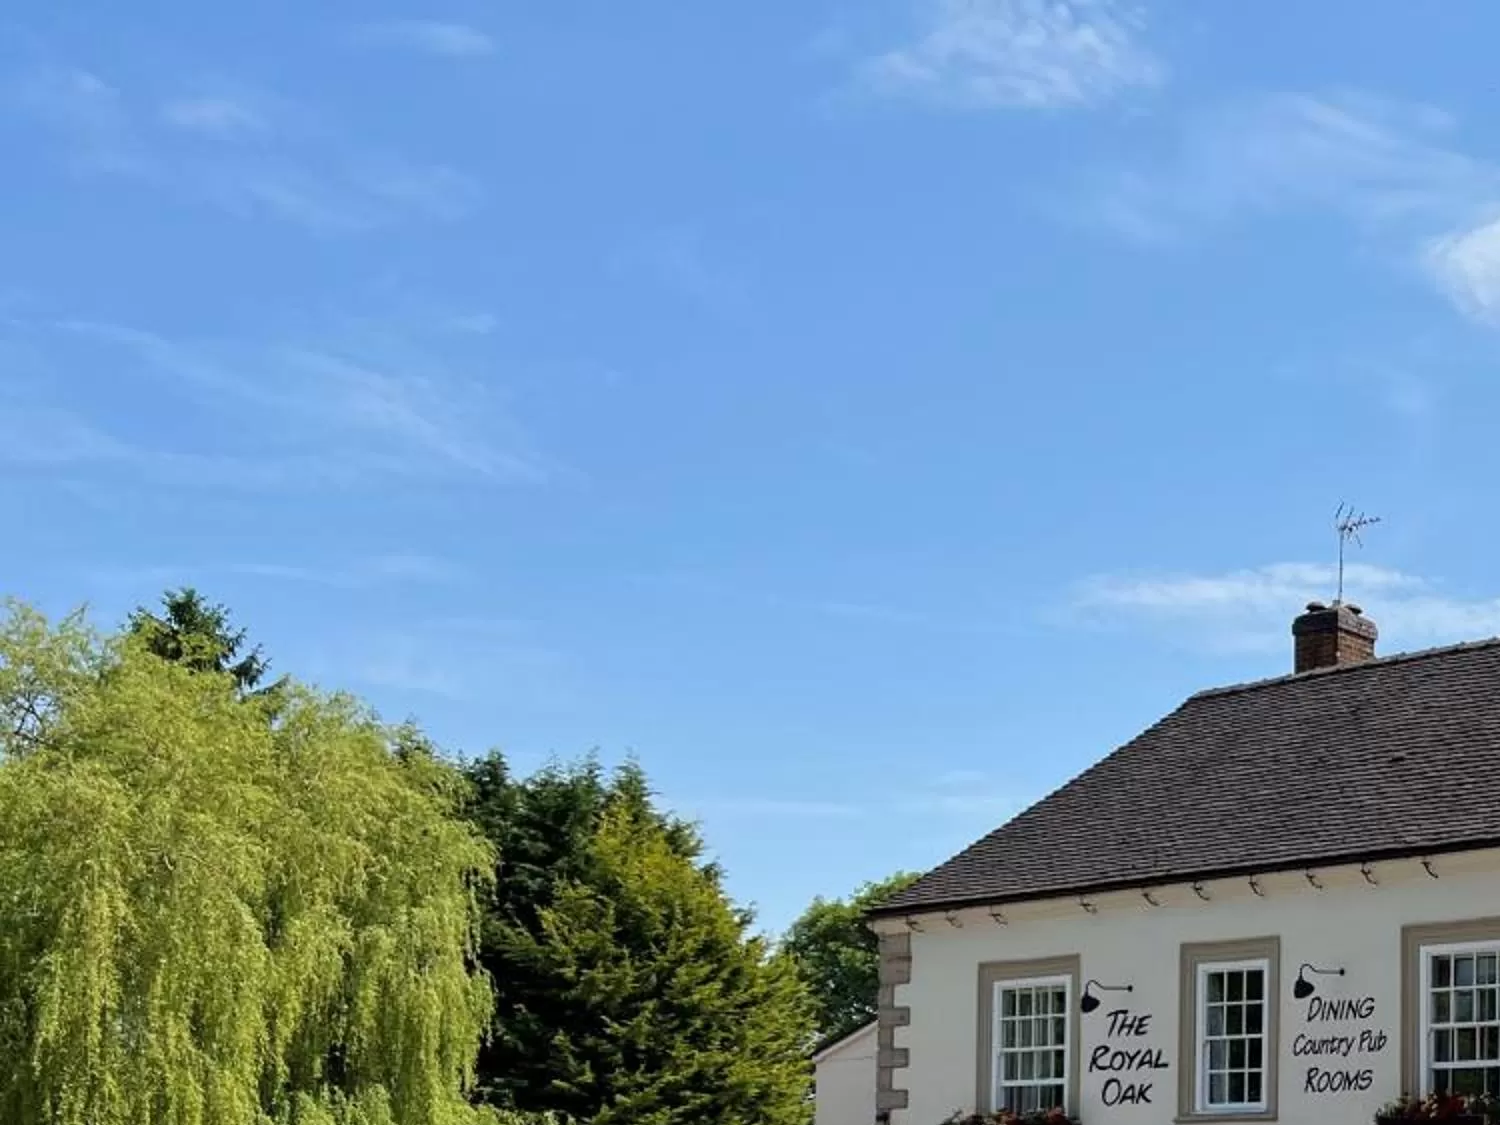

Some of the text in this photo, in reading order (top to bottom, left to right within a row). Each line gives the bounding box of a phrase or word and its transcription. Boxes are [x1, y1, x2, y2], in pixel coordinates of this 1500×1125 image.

[1307, 996, 1375, 1022] DINING
[1106, 1009, 1153, 1037] THE
[1293, 1030, 1388, 1057] Country Pub
[1088, 1045, 1170, 1073] ROYAL
[1100, 1078, 1153, 1107] OAK
[1304, 1067, 1373, 1093] ROOMS
